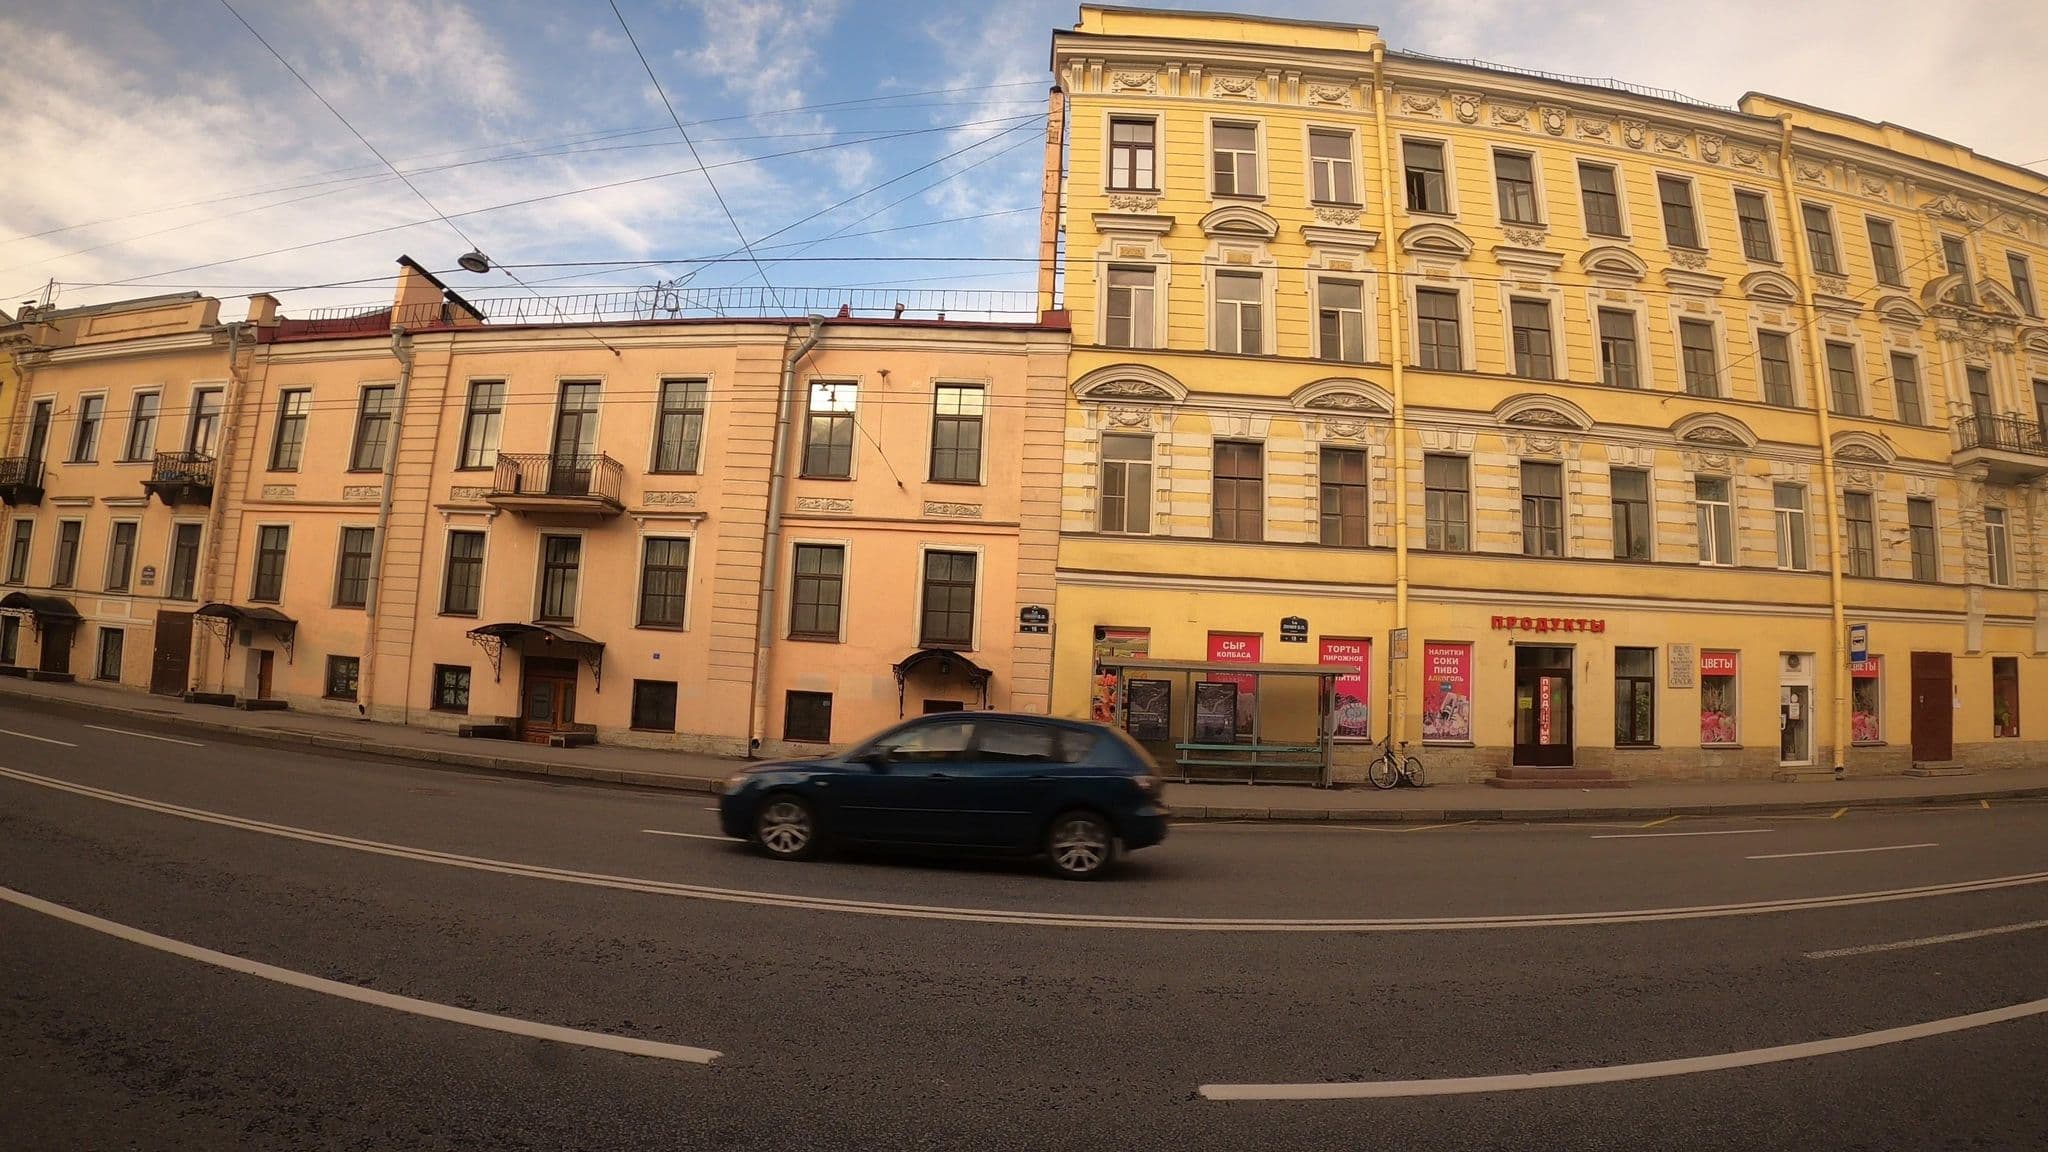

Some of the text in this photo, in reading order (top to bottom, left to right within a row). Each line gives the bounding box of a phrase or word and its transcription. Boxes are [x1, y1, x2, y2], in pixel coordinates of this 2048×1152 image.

[1491, 615, 1605, 633] ПРОДУКТЫ
[1222, 641, 1246, 650] СЫР
[1327, 645, 1360, 653] ТОРТЫ
[1428, 648, 1464, 656] НАПИТКИ
[1323, 654, 1363, 662] ПИРОЖНОЕ
[1433, 657, 1459, 665] СОКИ
[1701, 658, 1733, 669] ЦВЕТЫ
[1434, 666, 1459, 674] ПИВО
